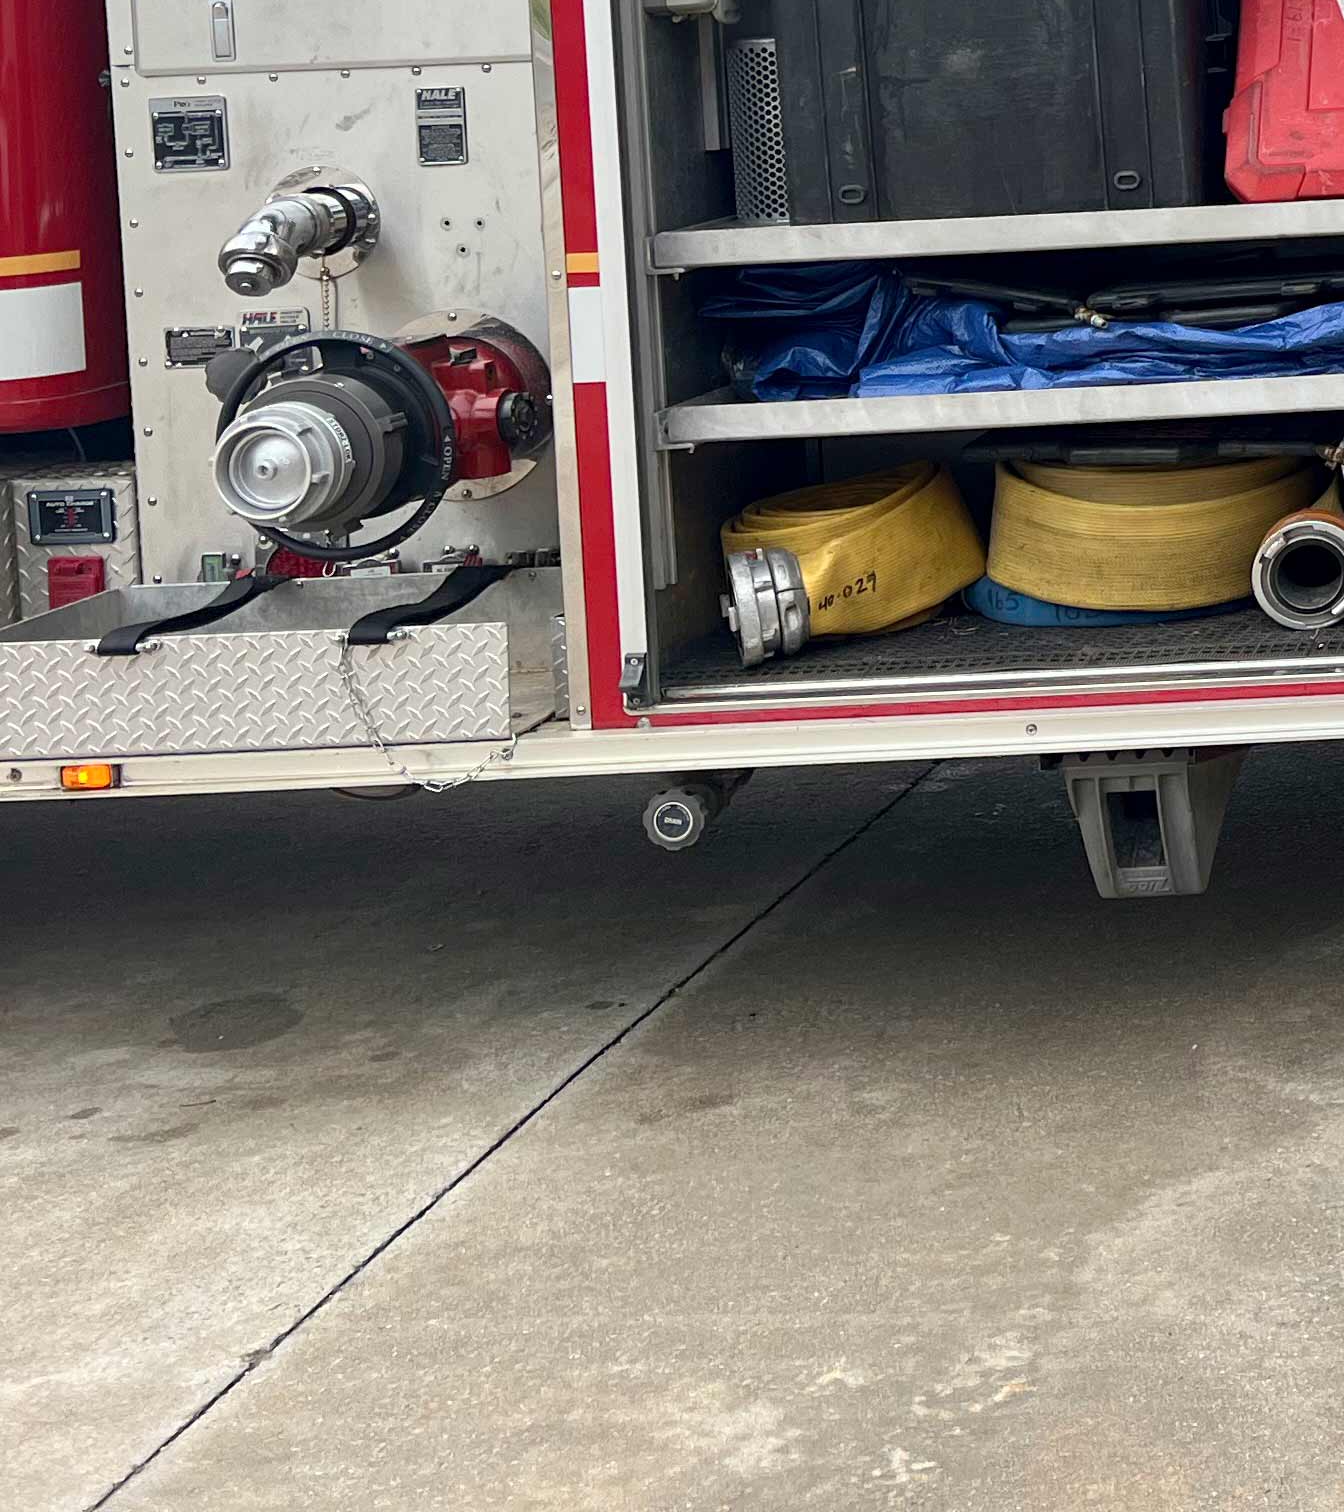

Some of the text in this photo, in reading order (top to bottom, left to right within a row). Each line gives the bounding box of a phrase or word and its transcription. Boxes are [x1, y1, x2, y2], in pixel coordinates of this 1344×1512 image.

[422, 89, 456, 100] HALE
[243, 312, 278, 325] HALE
[441, 447, 453, 481] OPEN
